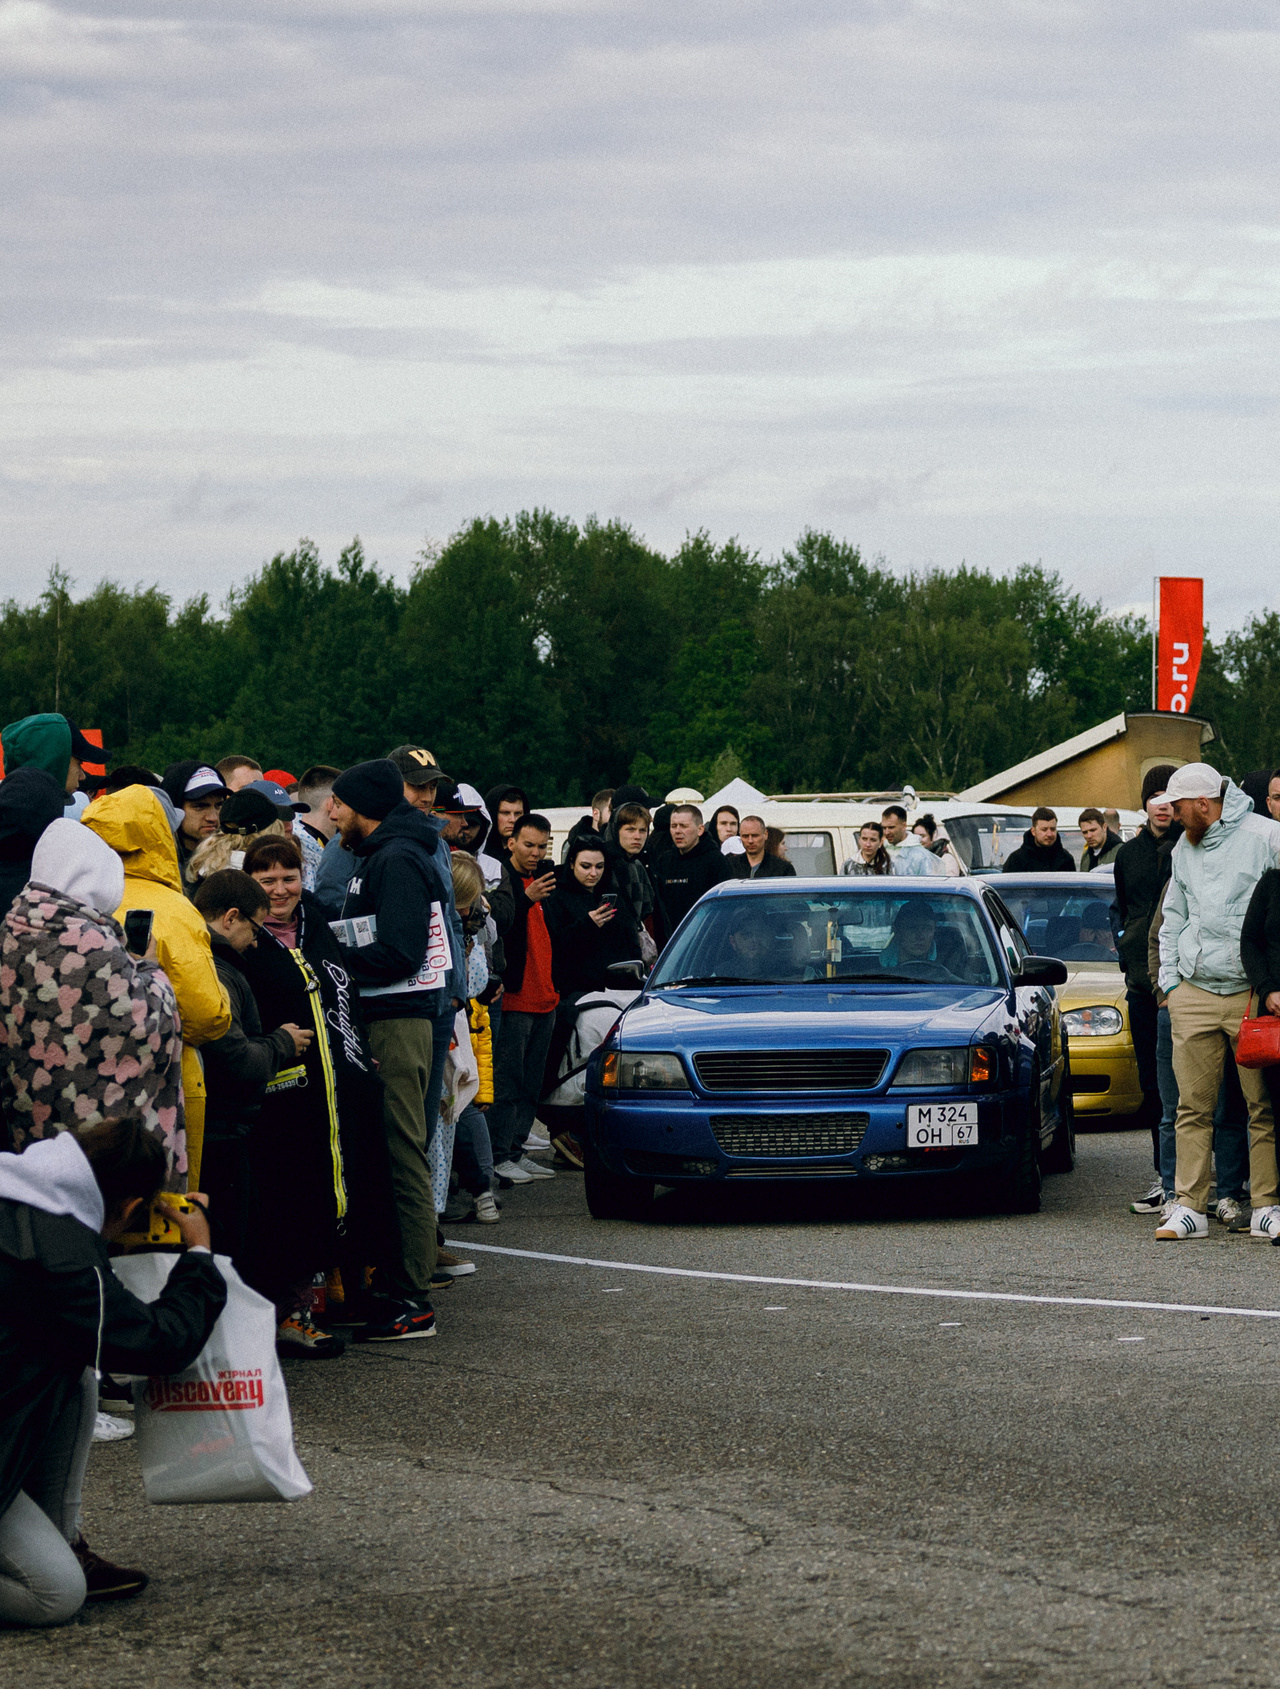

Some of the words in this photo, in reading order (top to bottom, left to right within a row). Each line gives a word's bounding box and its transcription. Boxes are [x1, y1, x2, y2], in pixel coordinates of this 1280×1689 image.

[408, 749, 436, 767] W
[322, 959, 369, 1072] Beautiful
[937, 1106, 967, 1122] 324
[957, 1126, 973, 1139] 67
